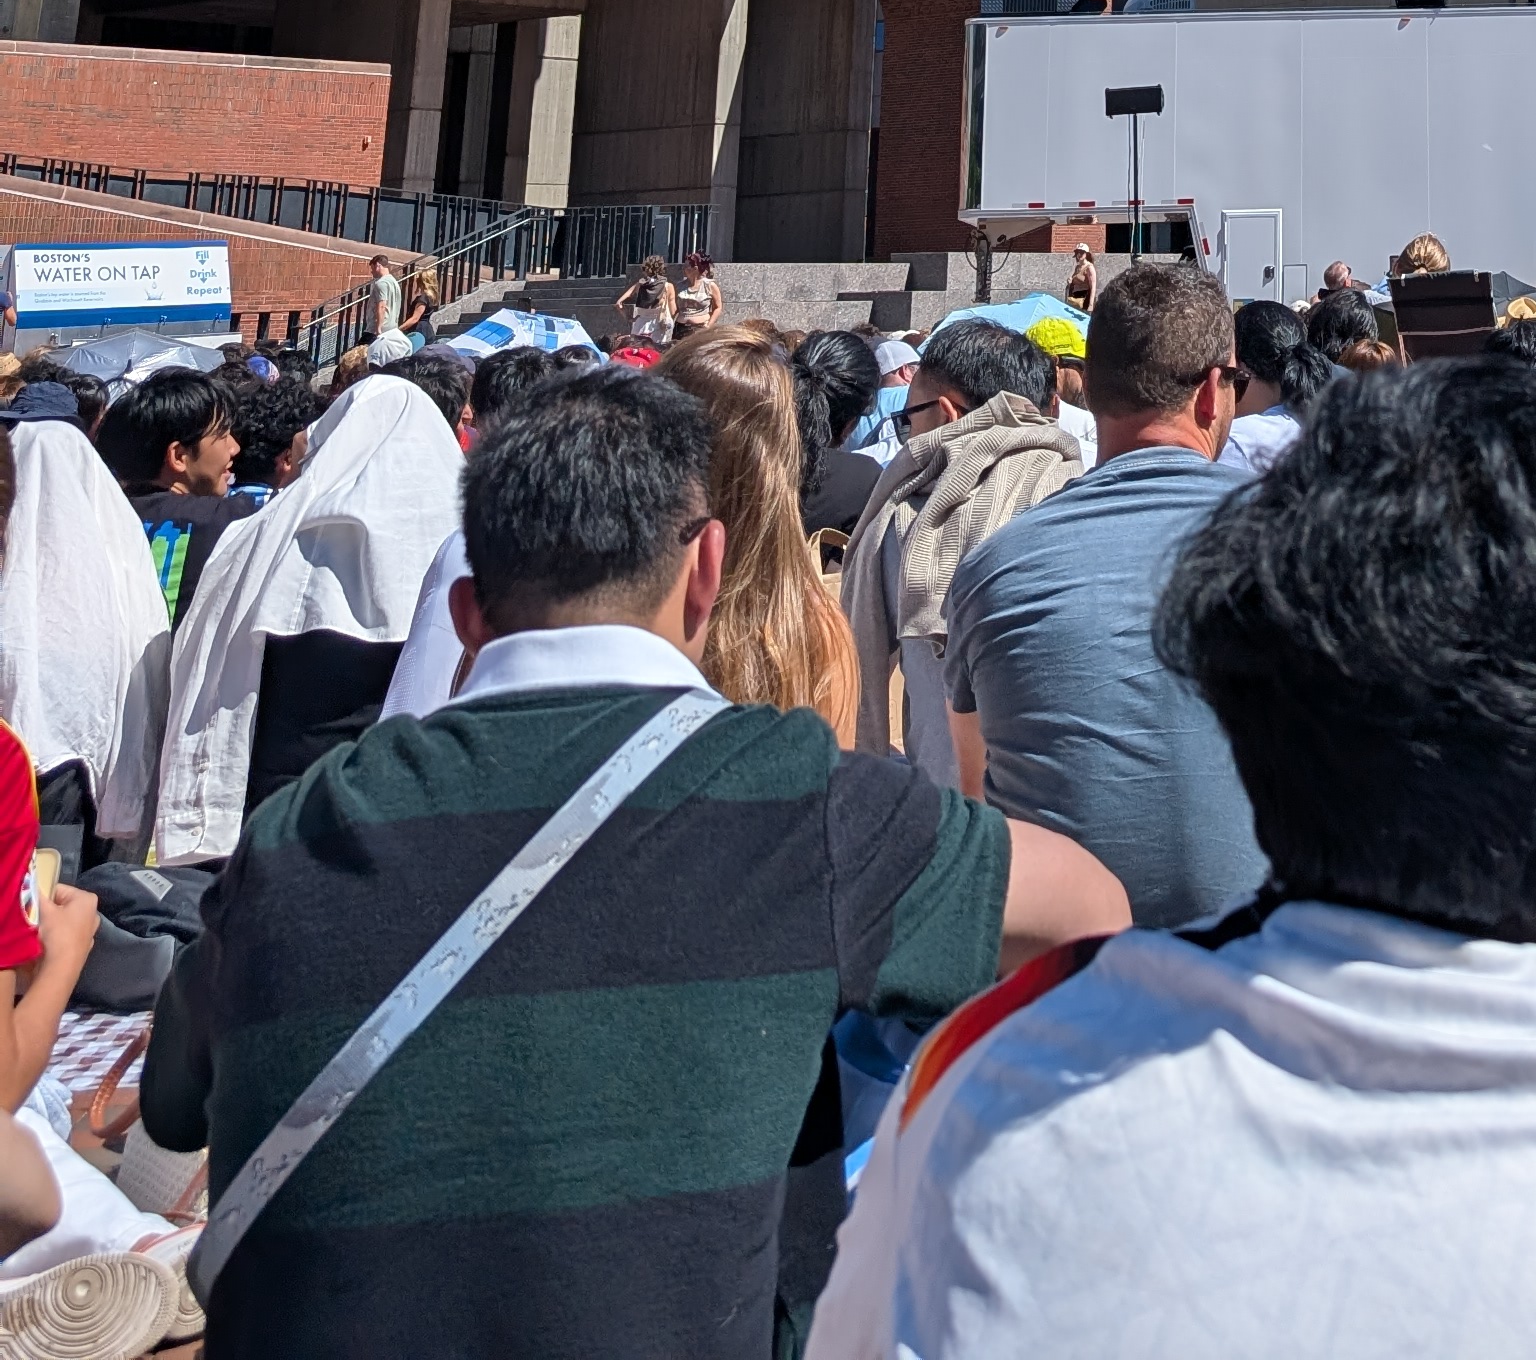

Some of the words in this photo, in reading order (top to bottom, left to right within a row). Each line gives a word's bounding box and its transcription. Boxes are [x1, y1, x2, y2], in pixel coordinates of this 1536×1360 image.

[33, 253, 91, 263] BOSTON'S
[195, 250, 209, 260] Fill
[34, 266, 93, 283] WATER
[97, 265, 127, 281] ON
[131, 265, 161, 280] TAP
[190, 268, 218, 279] Drink
[186, 286, 223, 298] Repeat
